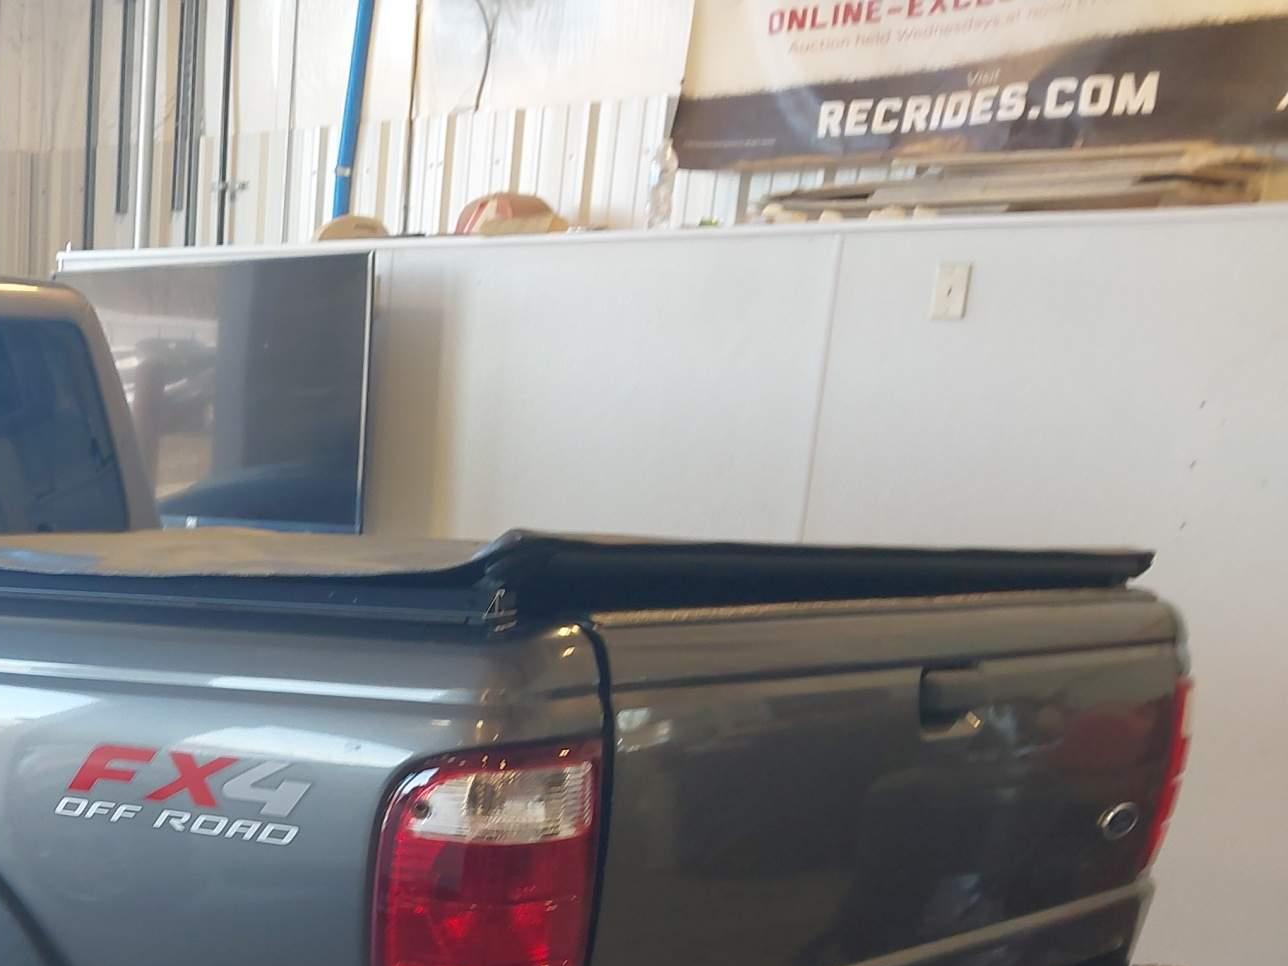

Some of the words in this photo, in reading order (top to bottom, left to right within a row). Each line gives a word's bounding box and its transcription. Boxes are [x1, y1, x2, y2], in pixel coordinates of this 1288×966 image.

[817, 71, 1160, 139] RECRIDES.COM
[967, 67, 1001, 87] Visit
[68, 743, 314, 818] FX4
[54, 796, 143, 823] OFF
[152, 809, 300, 846] ROAD
